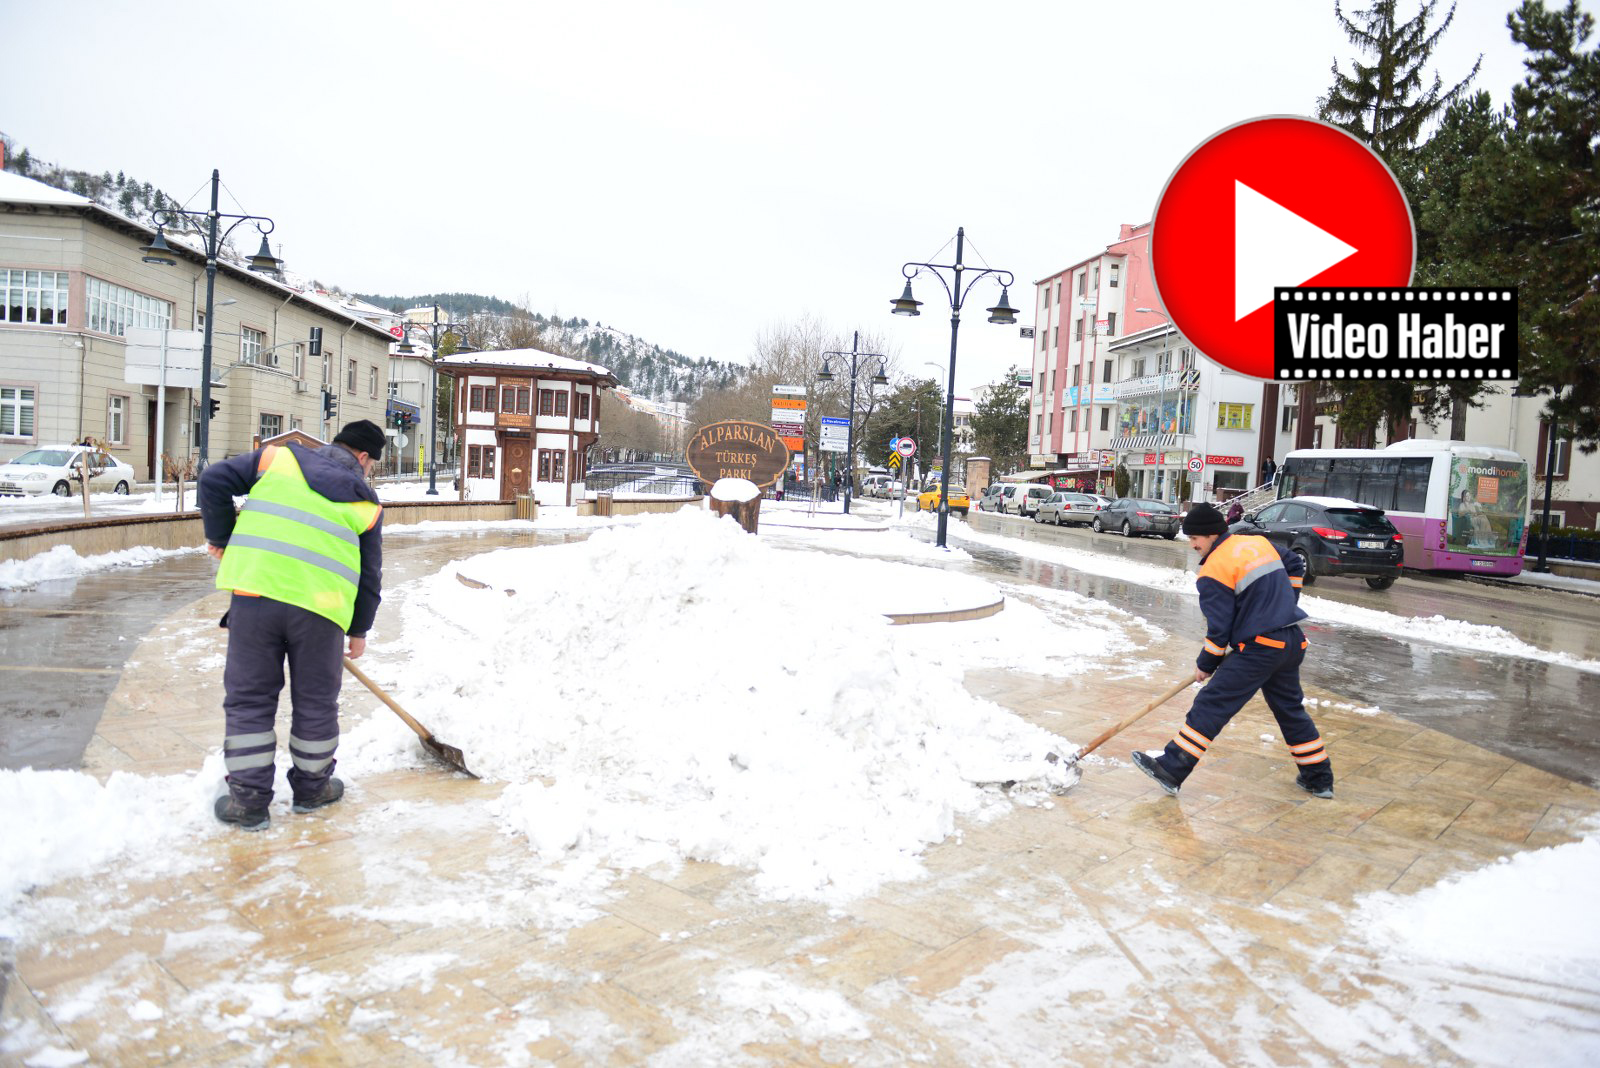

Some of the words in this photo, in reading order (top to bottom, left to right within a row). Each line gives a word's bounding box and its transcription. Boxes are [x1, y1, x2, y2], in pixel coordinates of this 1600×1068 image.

[700, 425, 775, 454] ALPARSLAN
[716, 450, 757, 467] TÜRKEŞ
[1207, 456, 1243, 465] ECZANE
[1190, 461, 1201, 469] 50
[720, 469, 752, 480] PARKI
[1468, 466, 1519, 478] mondihome
